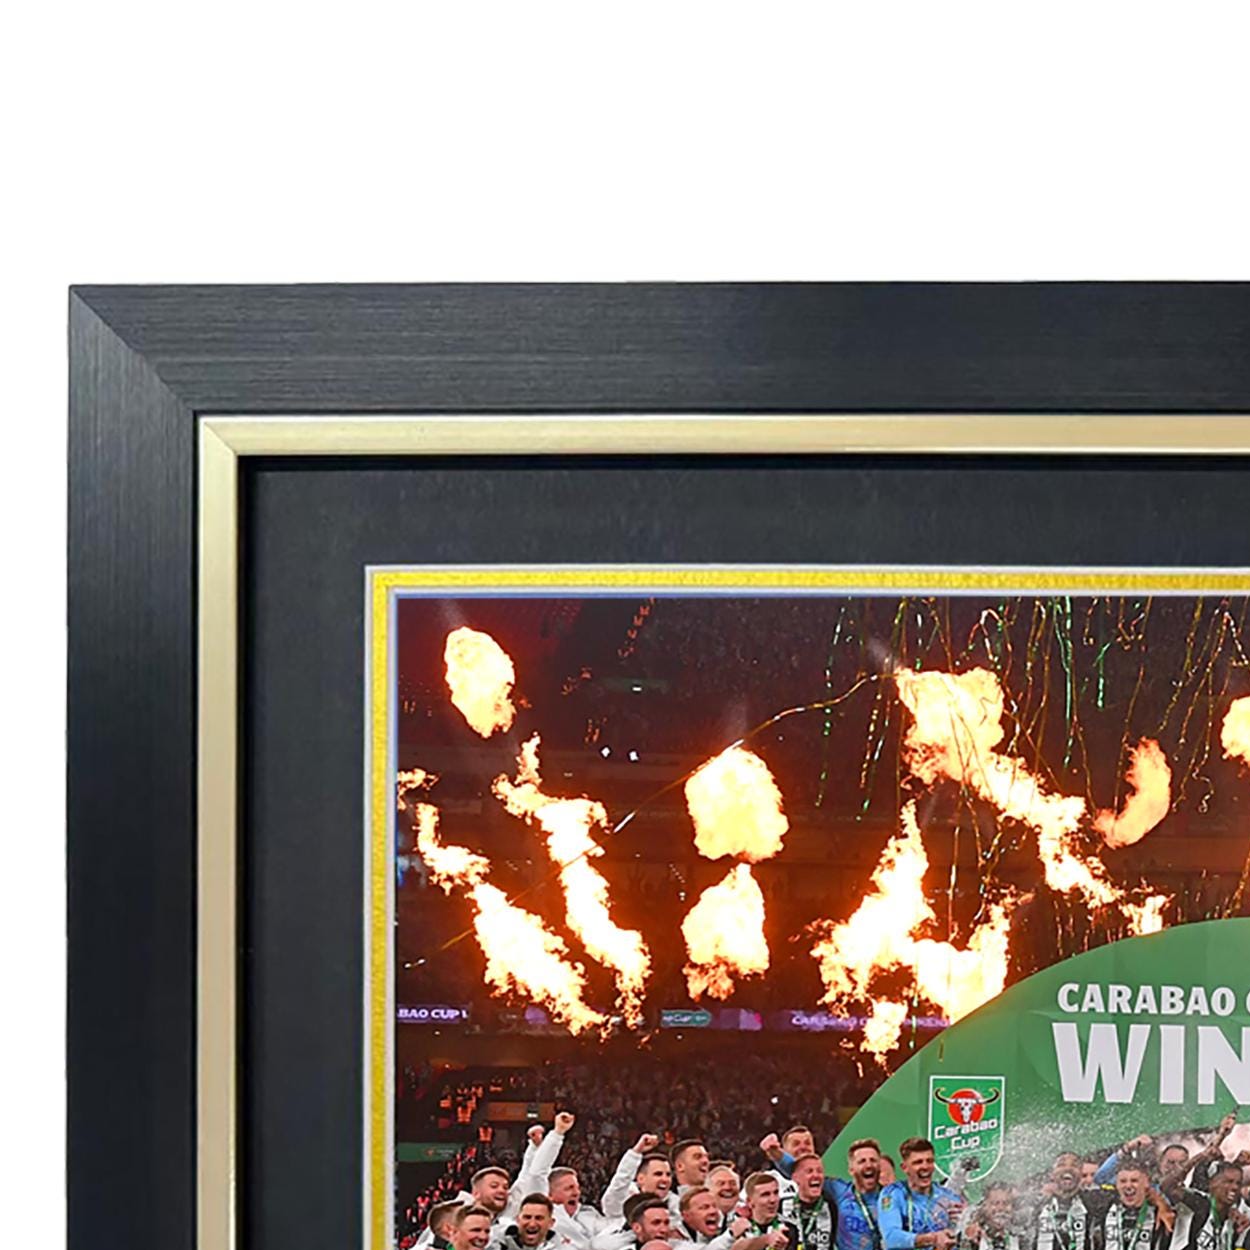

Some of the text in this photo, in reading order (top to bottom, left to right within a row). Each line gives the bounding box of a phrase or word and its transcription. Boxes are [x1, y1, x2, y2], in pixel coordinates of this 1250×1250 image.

[1057, 983, 1236, 1017] CARABAO
[430, 1008, 460, 1019] CUP
[934, 1118, 998, 1139] Carabao
[951, 1135, 981, 1150] Cup
